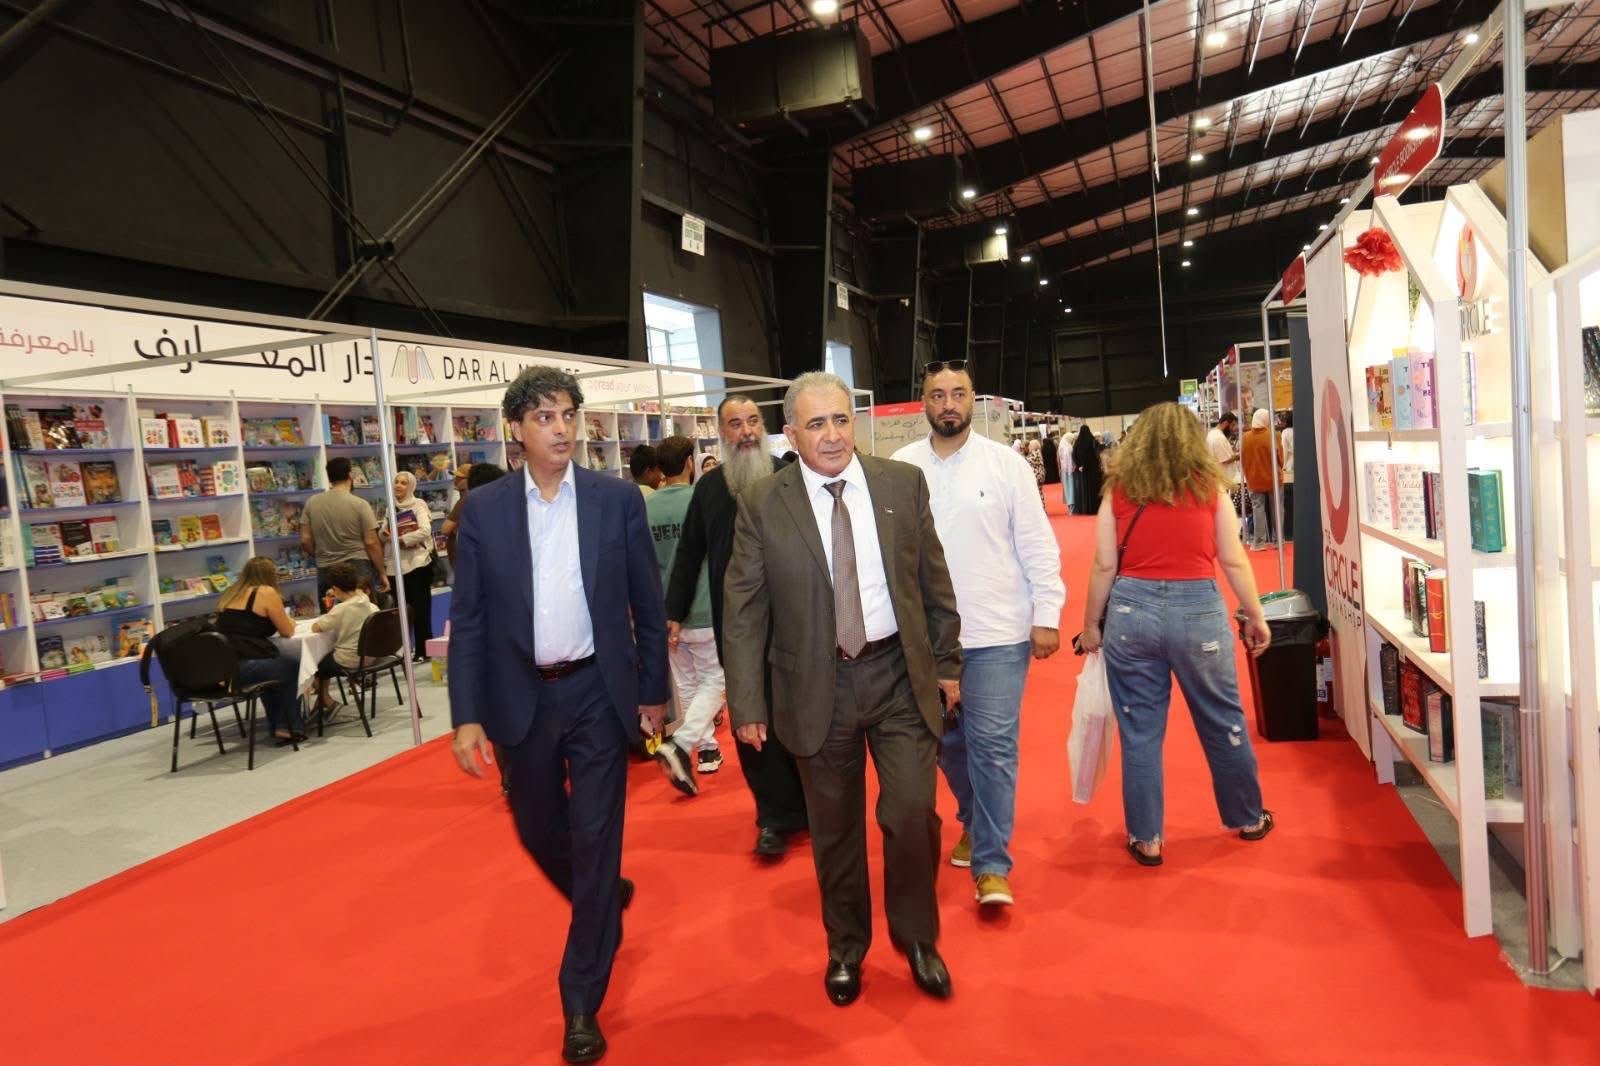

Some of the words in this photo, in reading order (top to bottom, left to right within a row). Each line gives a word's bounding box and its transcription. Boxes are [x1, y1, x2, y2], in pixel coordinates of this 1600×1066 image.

[443, 356, 482, 382] DAR
[489, 360, 511, 383] AL
[1325, 545, 1361, 611] CIRCLE
